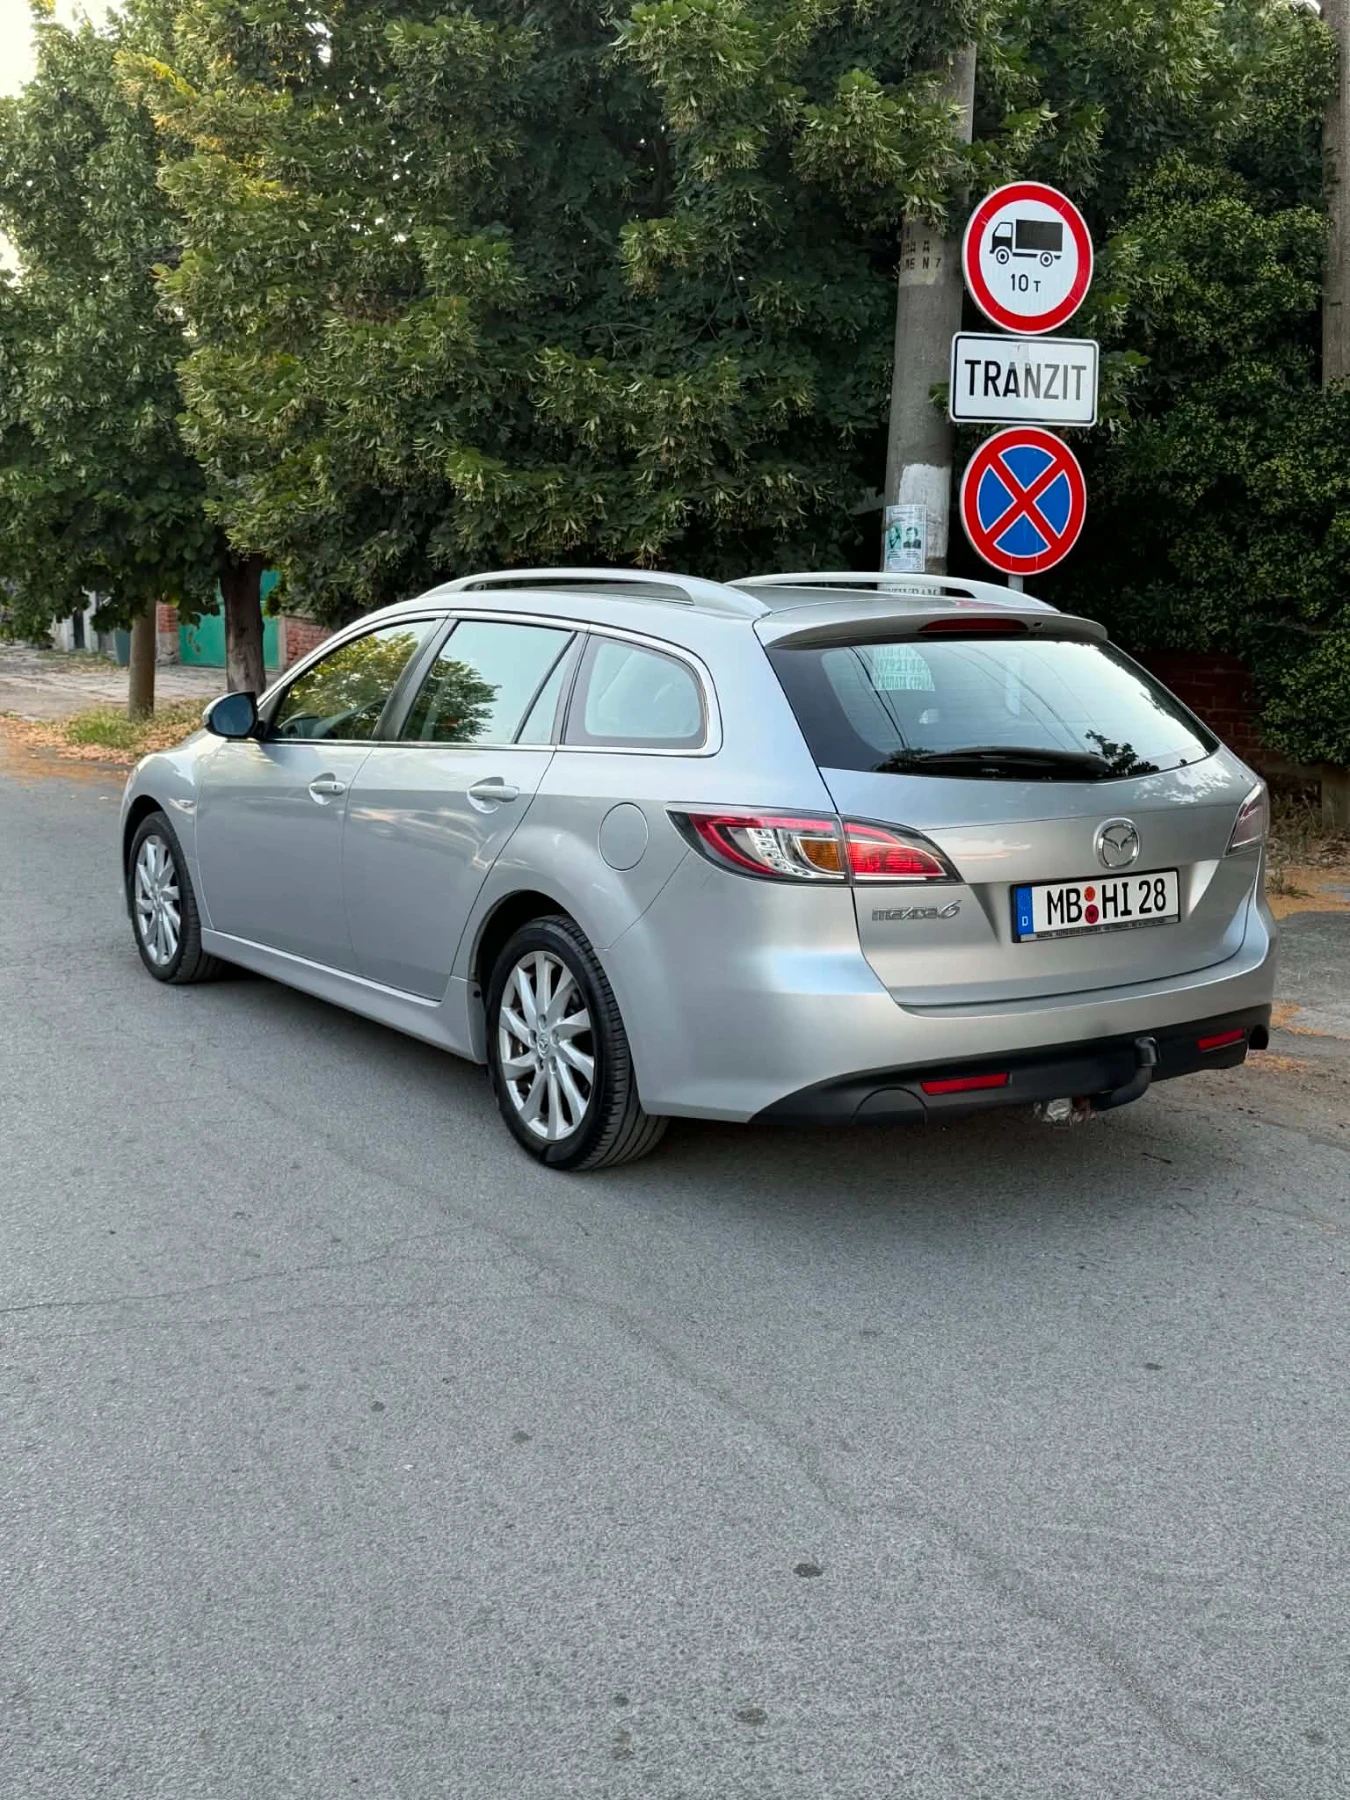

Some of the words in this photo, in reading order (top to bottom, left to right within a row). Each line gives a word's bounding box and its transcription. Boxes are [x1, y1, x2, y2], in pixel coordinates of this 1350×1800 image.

[1010, 273, 1029, 292] 10
[964, 359, 1087, 401] TRANZIT
[1047, 888, 1083, 925] MB
[1101, 882, 1132, 919] HI
[1138, 878, 1167, 914] 28
[1021, 915, 1029, 927] D
